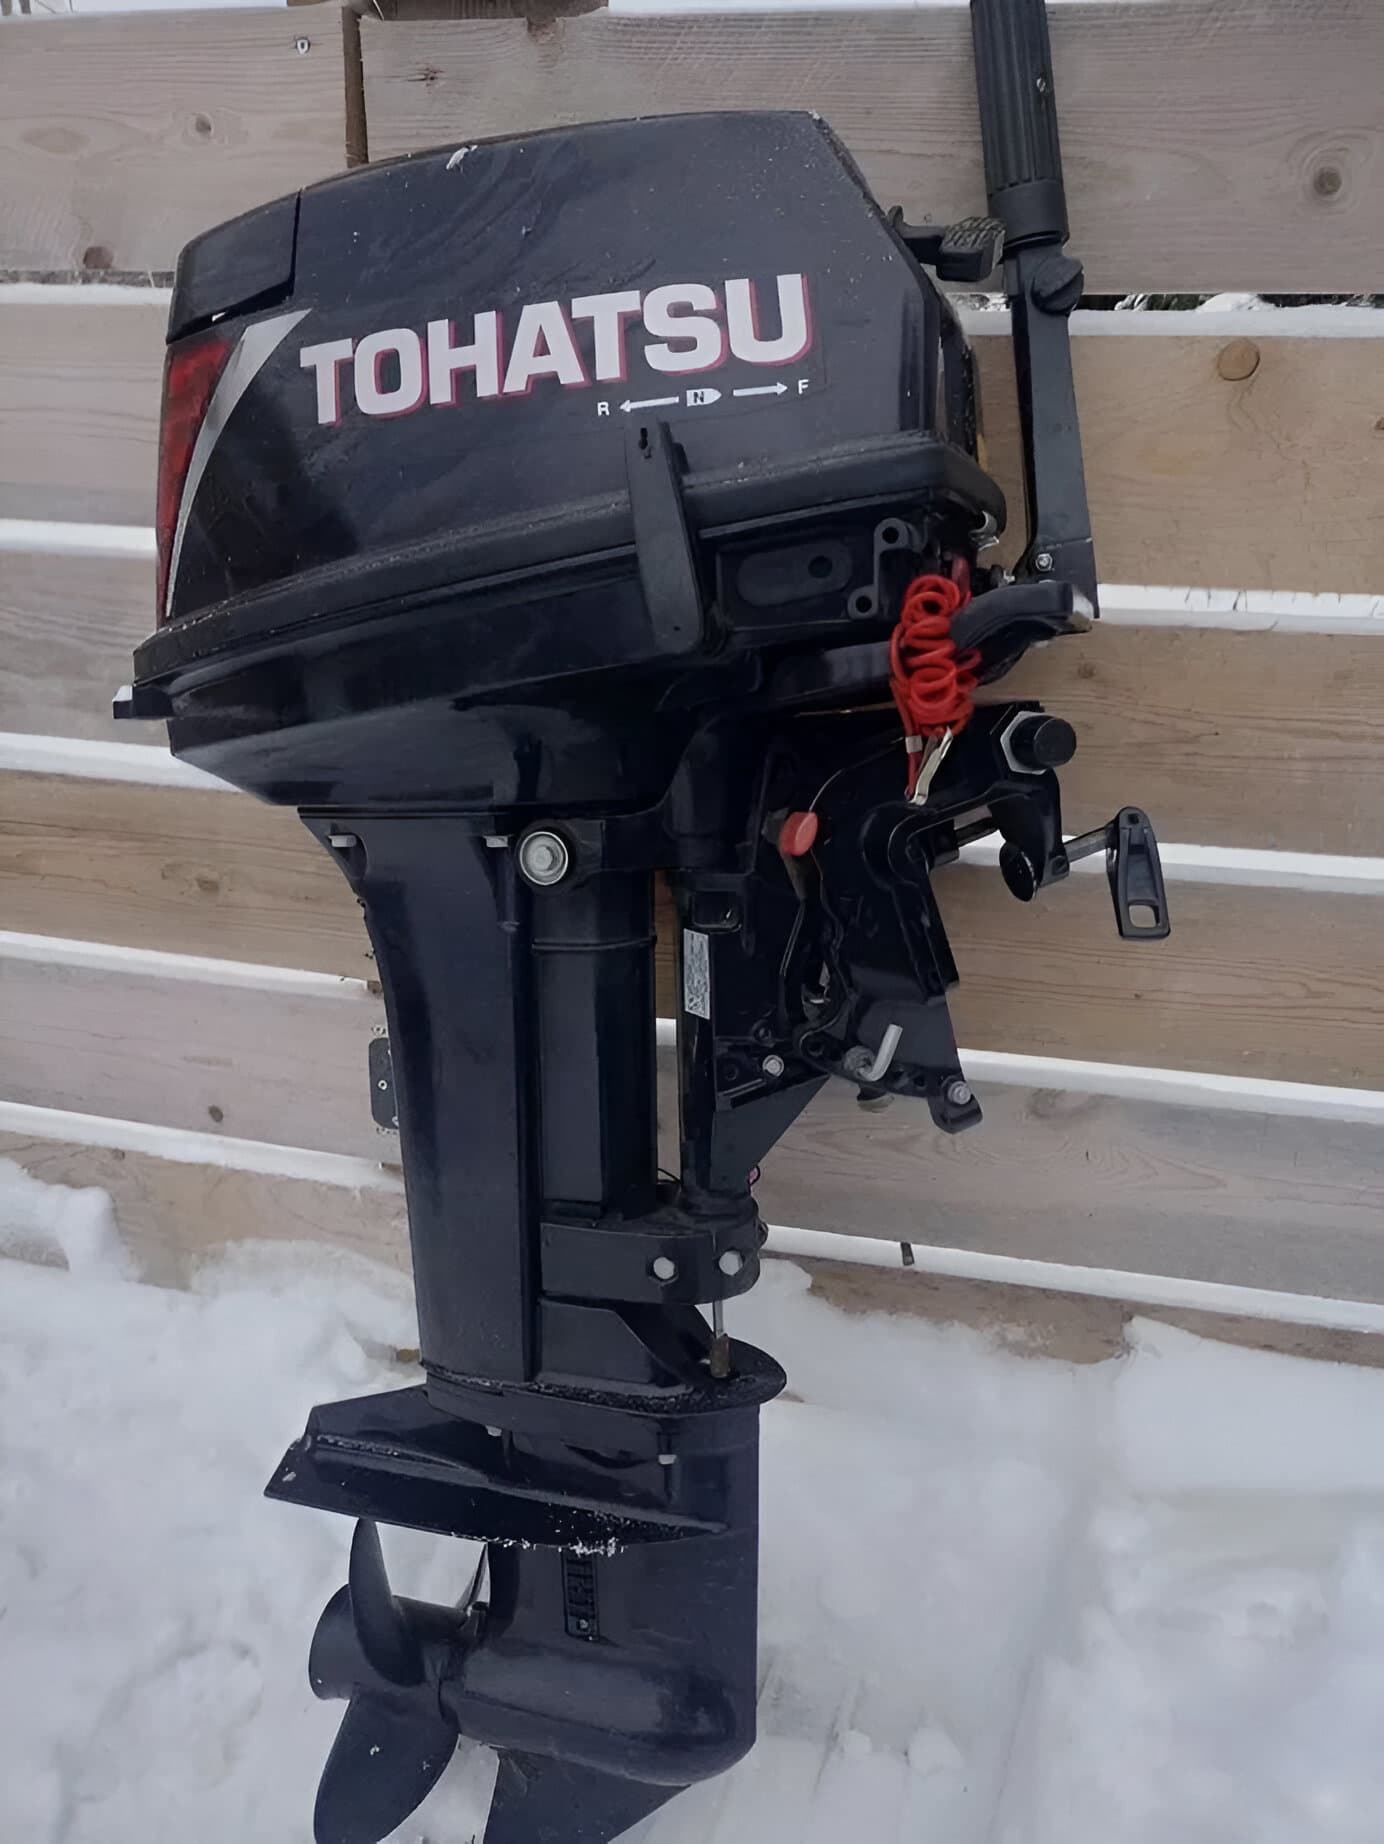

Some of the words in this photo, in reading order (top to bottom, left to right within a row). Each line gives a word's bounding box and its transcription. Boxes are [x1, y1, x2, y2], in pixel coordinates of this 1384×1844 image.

[299, 273, 813, 426] TOHATSU
[597, 401, 610, 417] R
[693, 391, 705, 404] N
[797, 378, 810, 395] F
